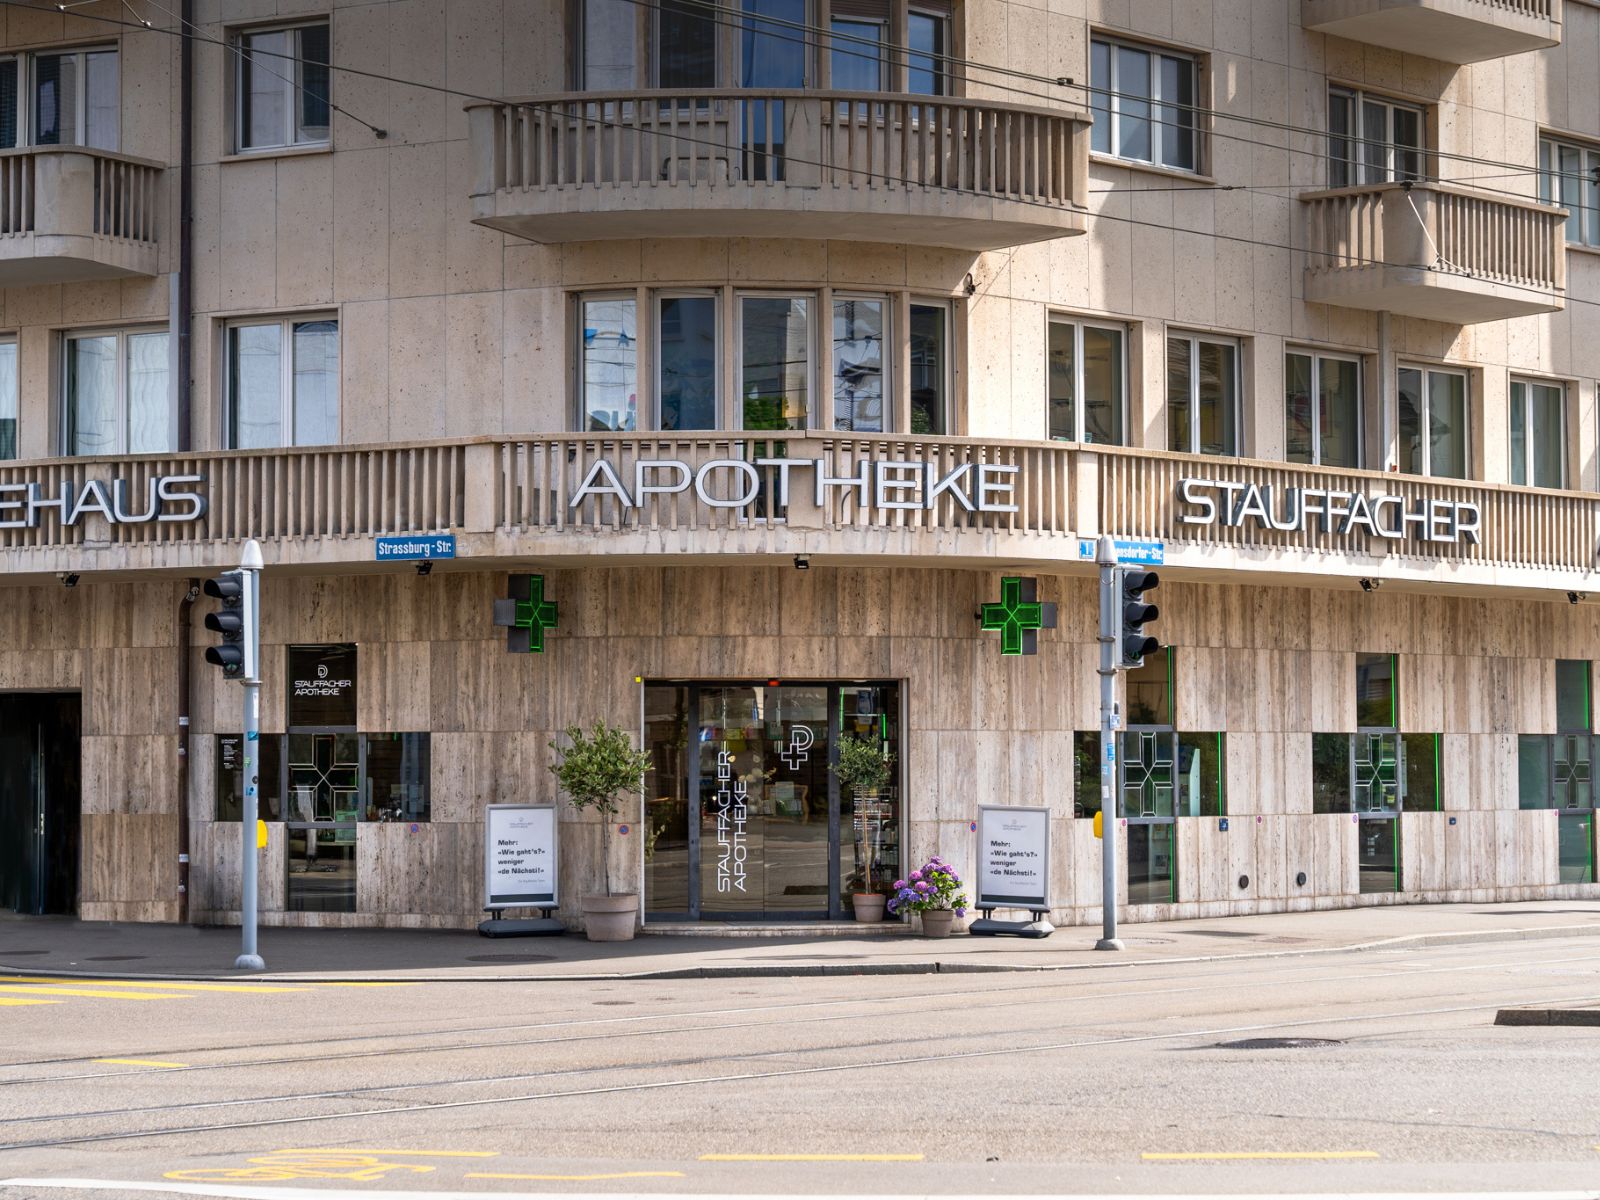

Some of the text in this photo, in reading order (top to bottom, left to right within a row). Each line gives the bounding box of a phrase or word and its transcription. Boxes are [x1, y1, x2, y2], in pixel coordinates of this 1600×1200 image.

[569, 458, 1020, 513] APOTHEKE
[1177, 477, 1481, 544] STAUFFACHER
[1115, 545, 1163, 560] ensdorfer-Str.
[294, 680, 352, 688] STAUFFACHER
[294, 688, 340, 696] APOTHEKE
[717, 751, 731, 893] STAUFFACHER
[734, 780, 747, 892] APOTHEKE
[497, 858, 525, 866] weniger
[990, 860, 1017, 868] weniger
